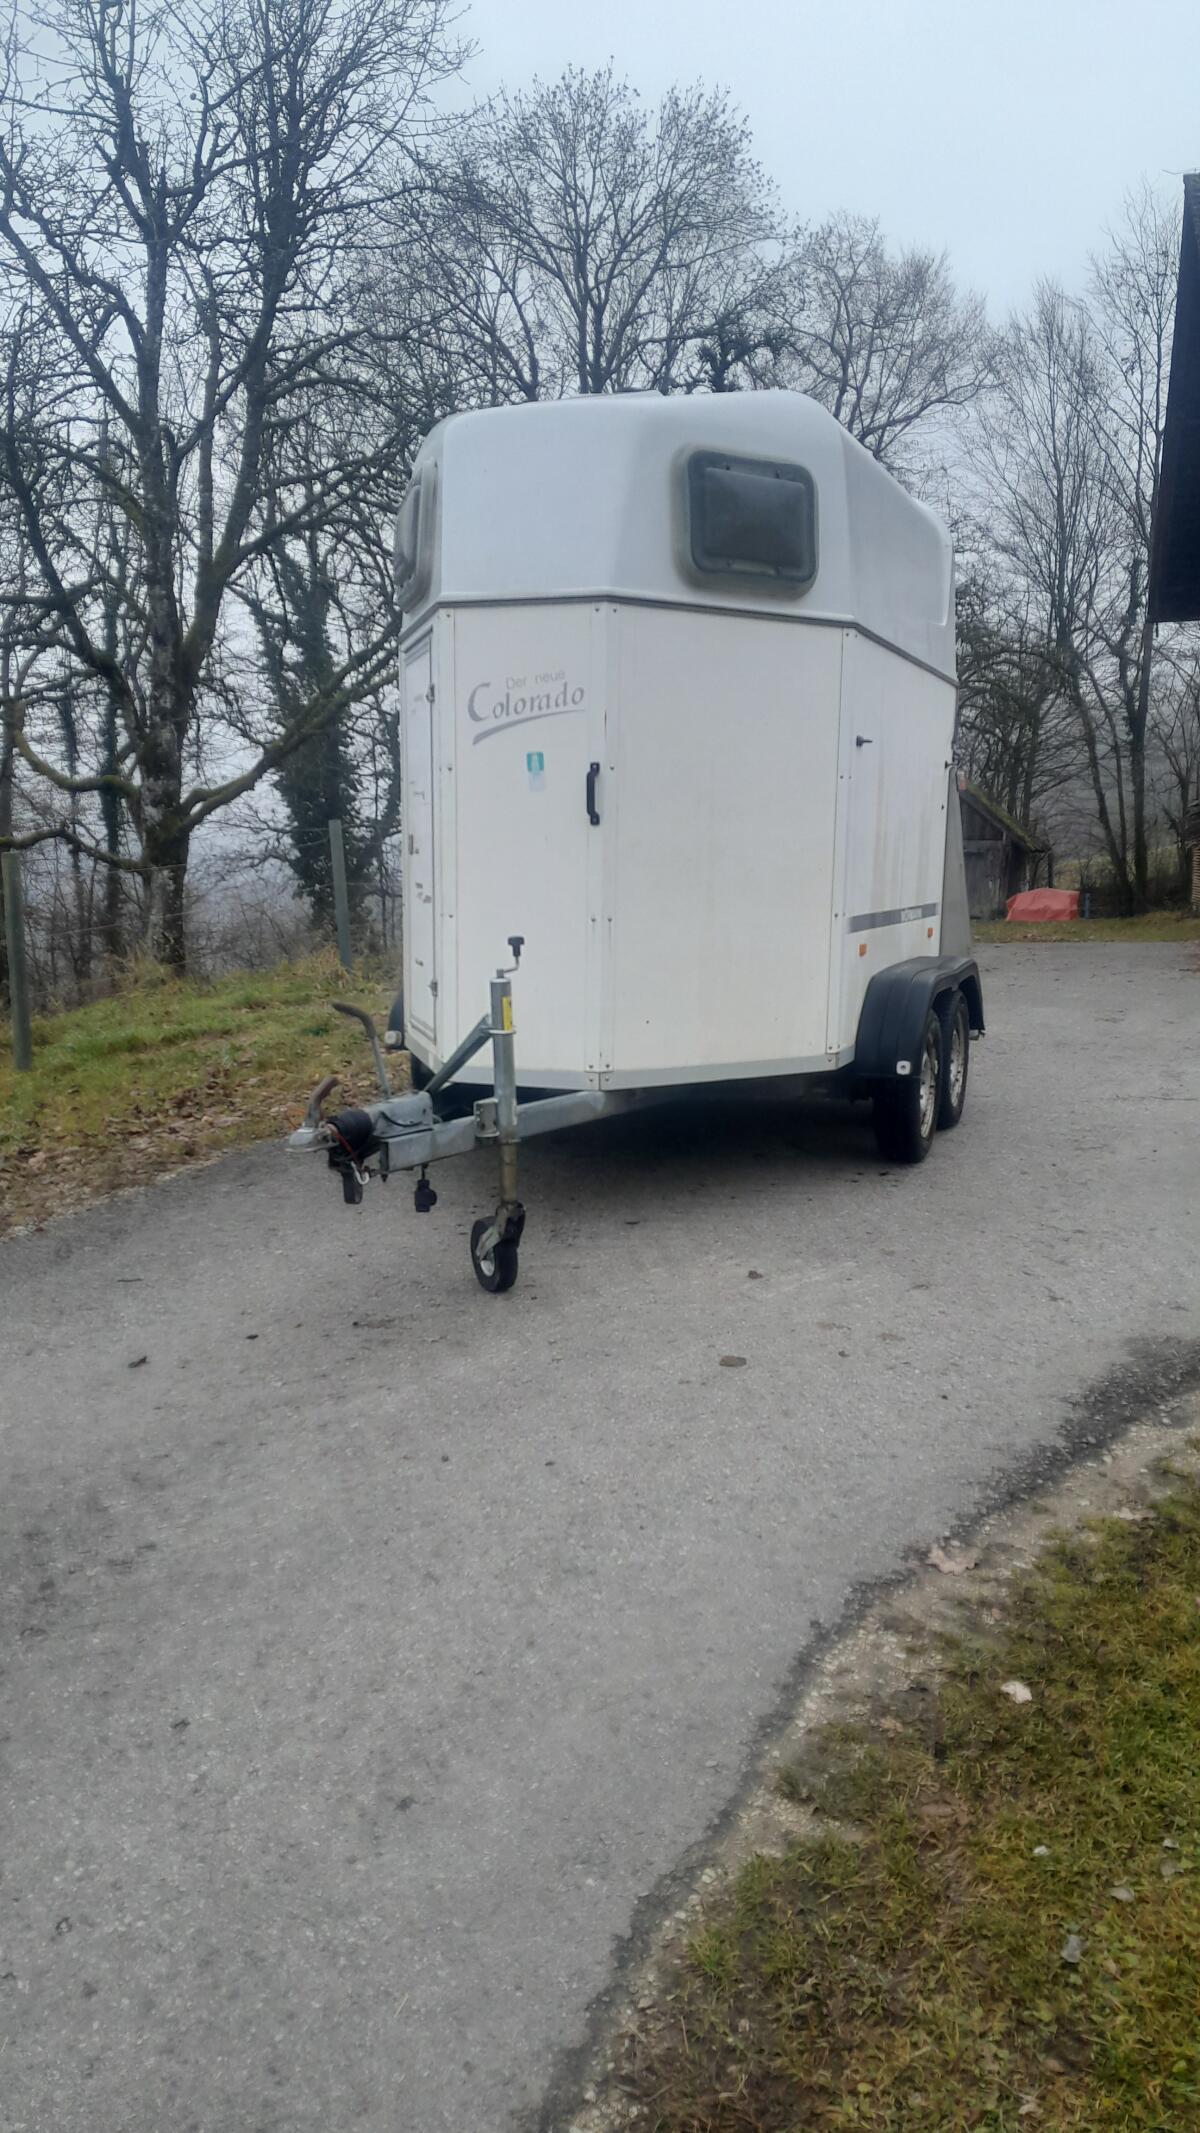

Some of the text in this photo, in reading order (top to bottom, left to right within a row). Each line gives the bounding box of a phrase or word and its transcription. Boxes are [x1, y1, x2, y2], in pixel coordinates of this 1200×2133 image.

[505, 670, 566, 690] Der neue
[467, 681, 585, 722] Colorado
